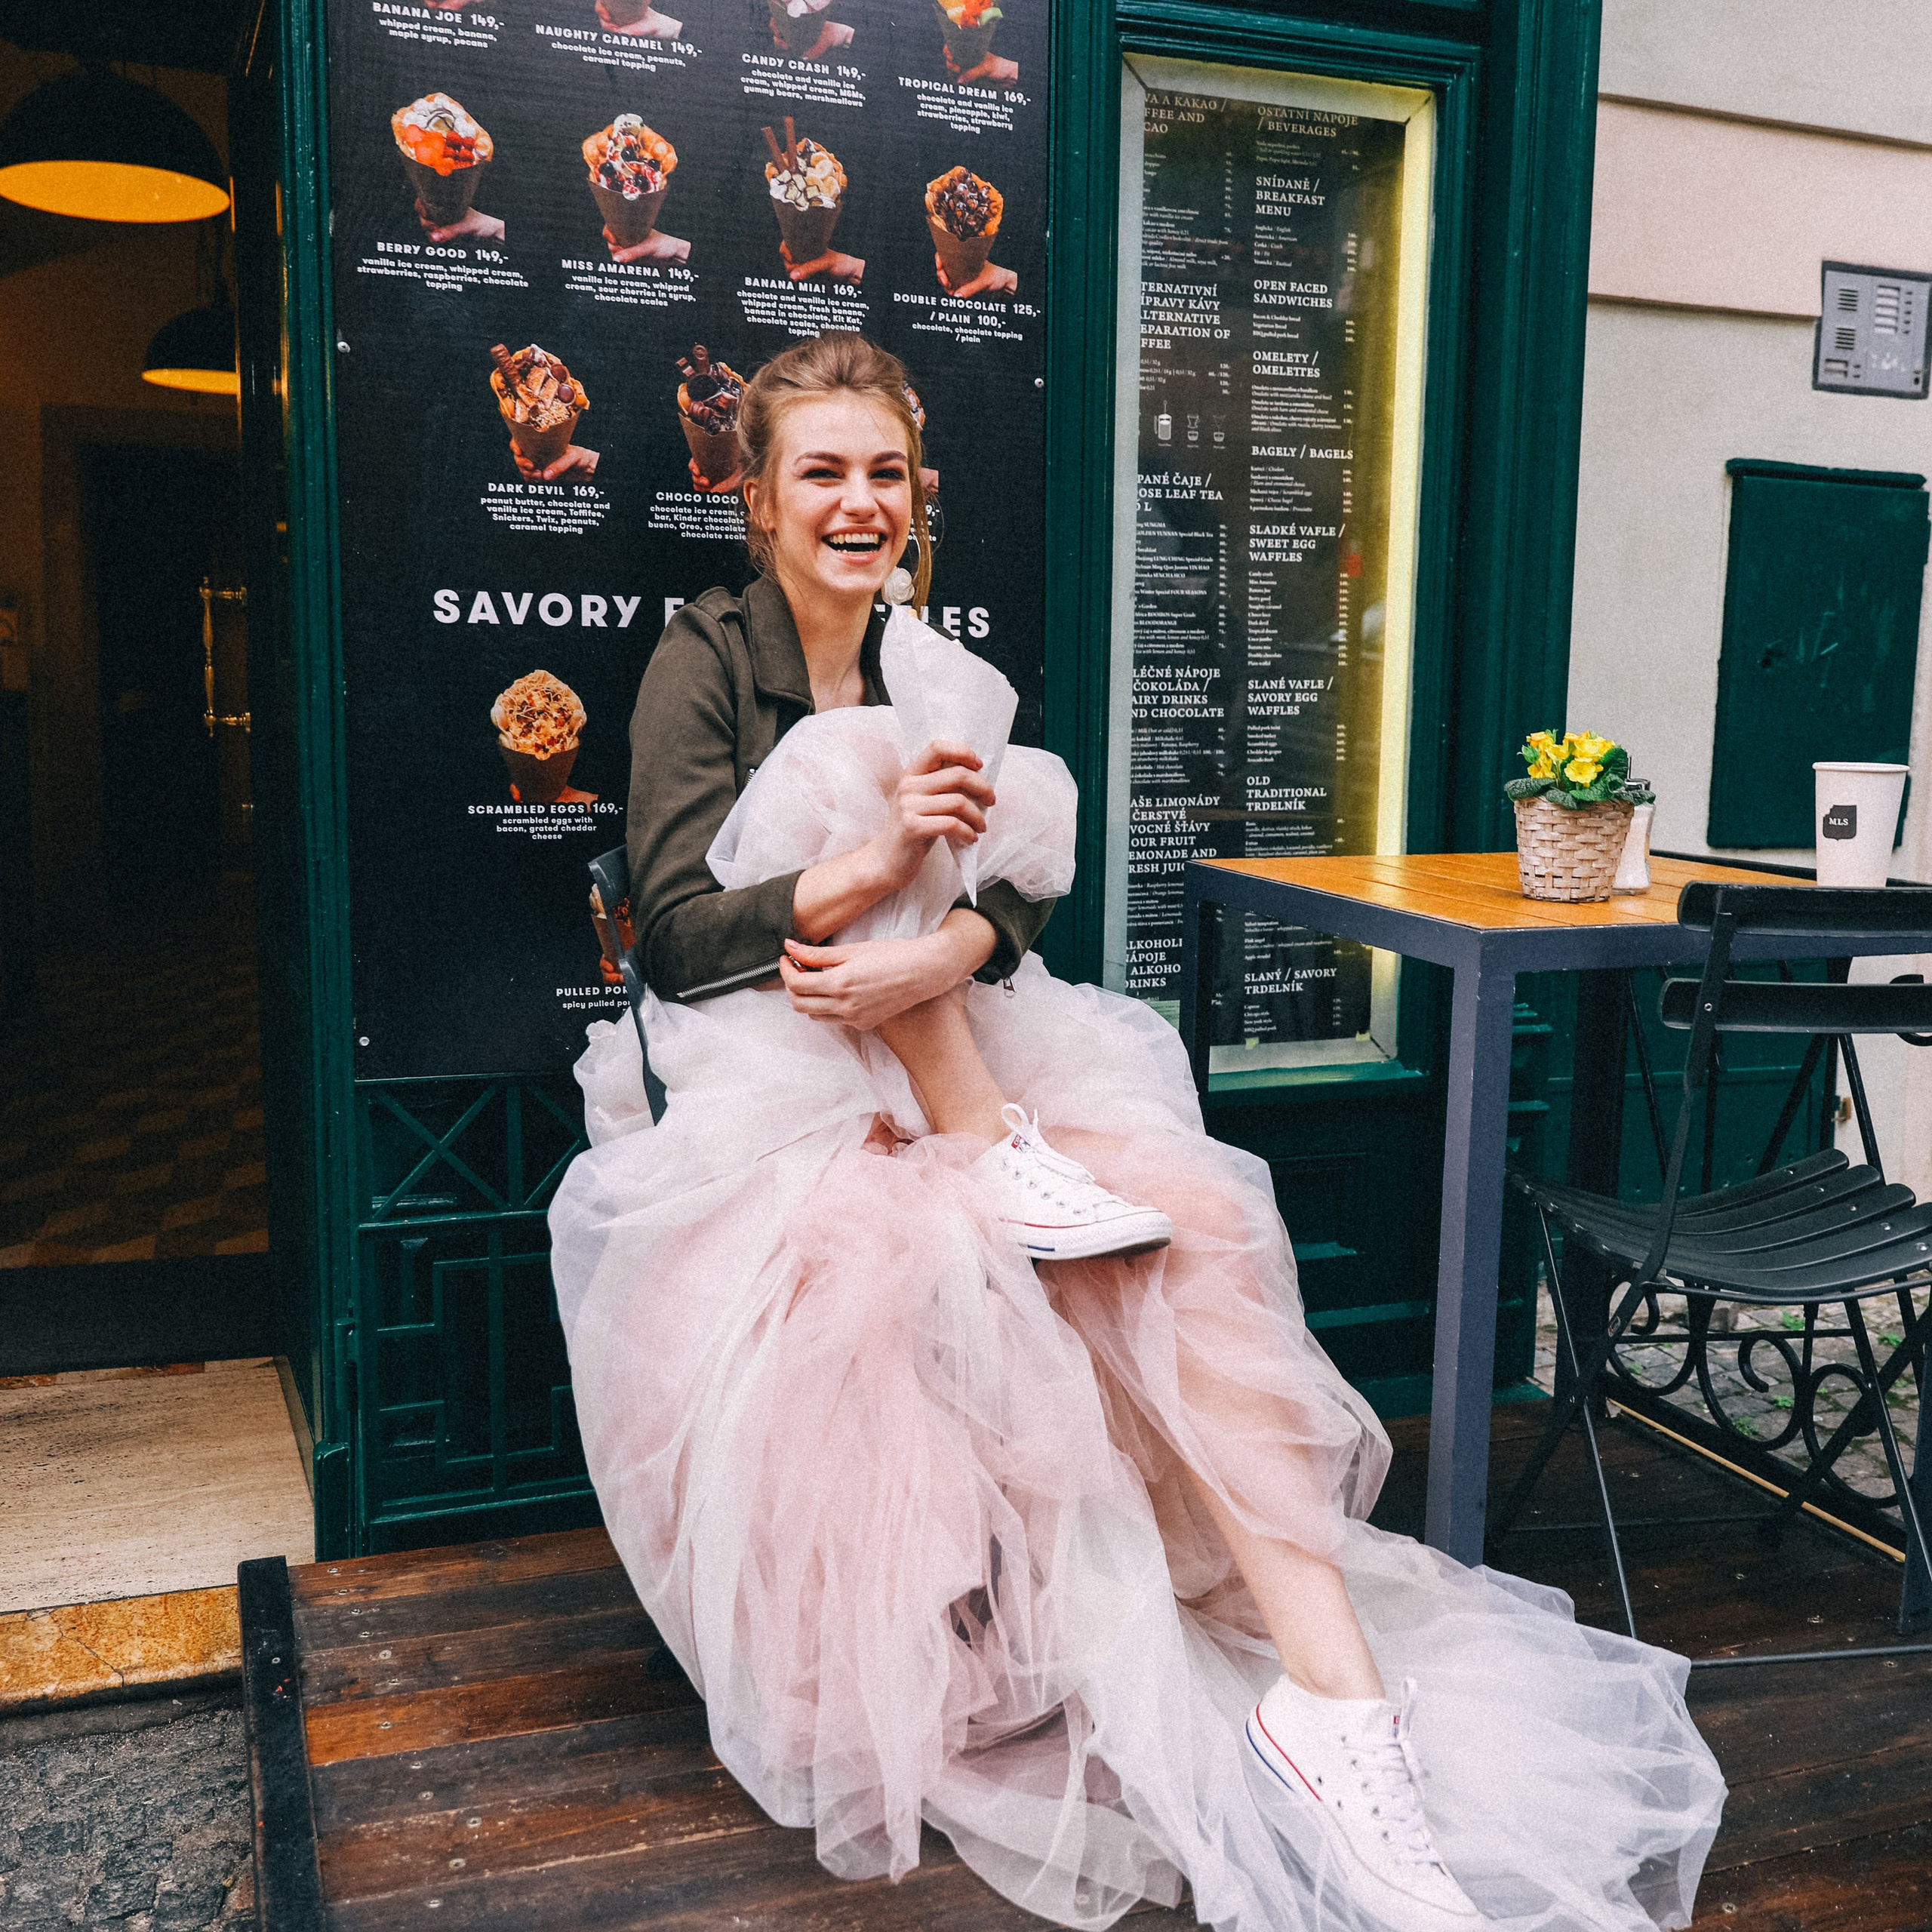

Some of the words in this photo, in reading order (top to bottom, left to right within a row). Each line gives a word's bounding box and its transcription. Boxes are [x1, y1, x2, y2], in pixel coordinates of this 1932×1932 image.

[373, 2, 431, 19] BANANA
[435, 11, 462, 23] JOE
[470, 14, 504, 29] 149,-
[379, 18, 420, 30] whipped
[423, 25, 455, 36] cream,
[458, 28, 497, 42] banana,
[389, 29, 419, 39] maple
[421, 34, 451, 45] syrup,
[454, 38, 488, 48] pecans
[535, 24, 598, 41] NAUGHTY
[602, 34, 663, 51] CARAMEL
[671, 42, 702, 57] 149,-
[552, 42, 596, 54] chocolate
[598, 47, 612, 56] ice
[614, 51, 645, 61] cream,
[648, 55, 686, 66] peanuts,
[583, 55, 619, 66] caramel
[622, 60, 656, 72] topping
[742, 54, 784, 67] CANDY
[789, 60, 829, 74] CRASH
[837, 66, 866, 81] 149,-
[898, 77, 955, 94] TROPICAL
[958, 86, 997, 100] DREAM
[1004, 91, 1031, 106] 169,-
[1175, 97, 1217, 110] KAKAO
[1268, 122, 1337, 137] BEVERAGES
[1257, 174, 1310, 189] SNÍDANĚ
[1256, 190, 1325, 205] BREAKFAST
[1256, 205, 1291, 216] MENU
[377, 242, 420, 254] BERRY
[426, 246, 466, 259] GOOD
[475, 249, 509, 264] 149,-
[362, 257, 395, 266] vanilla
[398, 260, 412, 268] ice
[414, 263, 447, 272] cream,
[449, 264, 489, 275] whipped
[491, 269, 523, 279] cream,
[561, 260, 593, 271] MISS
[598, 263, 660, 277] AMARENA
[668, 268, 699, 282] 149,-
[357, 266, 421, 278] strawberries,
[423, 272, 481, 284] raspberries,
[483, 276, 528, 287] chocolate
[426, 281, 463, 291] topping
[572, 275, 602, 284] vanilla
[605, 277, 618, 285] ice
[620, 279, 651, 289] cream,
[653, 282, 689, 292] whipped
[745, 277, 794, 291] BANANA
[798, 282, 826, 294] MIA!
[833, 284, 862, 298] 169,-
[1141, 282, 1217, 297] TERNATIVNÍ
[1254, 280, 1286, 291] OPEN
[1290, 282, 1327, 294] FACED
[565, 284, 595, 292] cream,
[620, 287, 656, 297] cherries
[669, 292, 696, 302] syrup,
[595, 294, 638, 304] chocolate
[640, 298, 668, 306] scales
[894, 293, 937, 305] DOUBLE
[940, 297, 1006, 312] CHOCOLATE
[1013, 303, 1041, 318] 125,-
[1141, 293, 1185, 308] ÍPRAVY
[1189, 297, 1220, 311] KÁVY
[1254, 294, 1333, 308] SANDWICHES
[938, 312, 971, 324] PLAIN
[977, 315, 1006, 328] 100,-
[1141, 310, 1220, 325] LTERNATIVE
[1140, 325, 1210, 337] EPARATION
[1214, 330, 1230, 339] OF
[1253, 351, 1309, 363] OMELETY
[1253, 365, 1320, 377] OMELETTES
[1252, 446, 1297, 457] BAGELY
[1309, 448, 1353, 459] BAGELS
[1173, 472, 1201, 488] ČAJE
[488, 483, 523, 494] DARK
[528, 485, 565, 495] DEVIL
[573, 485, 605, 499] 169,-
[1165, 489, 1196, 500] LEAF
[1200, 491, 1223, 500] TEA
[515, 498, 545, 507] butter,
[547, 500, 591, 509] chocolate
[656, 492, 702, 503] CHOCO
[706, 494, 739, 504] LOCO
[492, 513, 534, 523] Snickers,
[536, 516, 558, 525] Twix,
[569, 509, 605, 518] Toffifee,
[549, 525, 583, 534] topping
[648, 521, 677, 530] bueno,
[679, 522, 703, 531] Oreo,
[1250, 523, 1296, 535] SLADKÉ
[1300, 526, 1336, 536] VAFLE
[1249, 539, 1289, 548] SWEET
[1292, 540, 1315, 549] EGG
[1249, 552, 1303, 562] WAFFLES
[432, 589, 641, 628] SAVORY
[1133, 666, 1171, 678] LÉČNÉ
[1175, 666, 1220, 680] NÁPOJE
[1134, 678, 1199, 691] ČOKOLÁDA
[1248, 677, 1285, 690] SLANÉ
[1288, 680, 1324, 689] VAFLE
[1132, 695, 1158, 704] AIRY
[1162, 695, 1208, 704] DRINKS
[1247, 693, 1292, 702] SAVORY
[1295, 693, 1318, 702] EGG
[1151, 708, 1224, 717] CHOCOLATE
[1247, 706, 1300, 715] WAFFLES
[1247, 777, 1270, 785] OLD
[1246, 788, 1327, 798] TRADITIONAL
[1131, 795, 1152, 808] AŠE
[1155, 794, 1220, 807] LIMONÁDY
[1246, 798, 1306, 811] TRDELNÍK
[468, 805, 545, 814] SCRAMBLED
[550, 804, 585, 814] EGGS
[593, 803, 623, 815] 169,-
[1133, 808, 1186, 821] ČERSTVÉ
[1130, 820, 1171, 834] VOCNÉ
[1829, 817, 1848, 826] MLS
[1131, 838, 1157, 847] OUR
[1160, 836, 1195, 846] FRUIT
[1129, 849, 1188, 860] EMONADE
[1191, 848, 1217, 857] AND
[1129, 863, 1158, 873] RESH
[1131, 964, 1181, 975] ALKOHO
[1244, 968, 1281, 982] SLANÝ
[1294, 968, 1337, 979] SAVORY
[556, 987, 600, 996] PULLED
[605, 986, 628, 995] POR
[1244, 980, 1303, 995] TRDELNÍK
[589, 1000, 614, 1008] pulled
